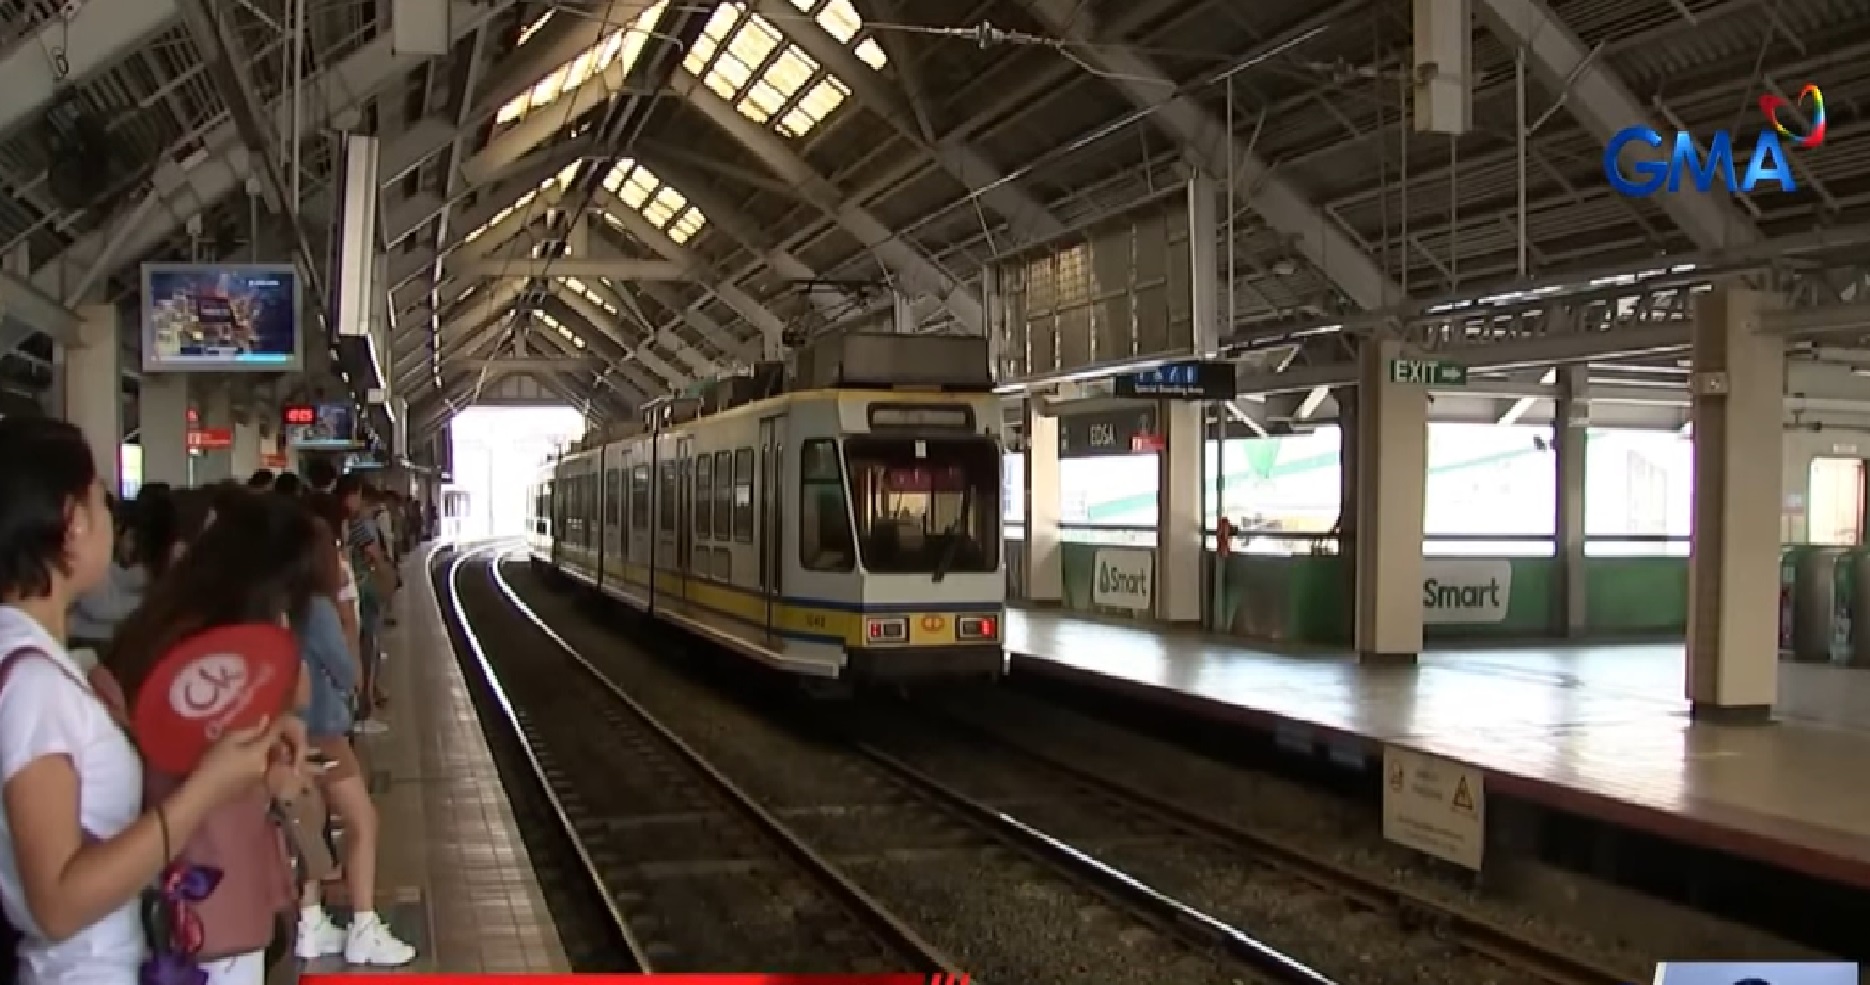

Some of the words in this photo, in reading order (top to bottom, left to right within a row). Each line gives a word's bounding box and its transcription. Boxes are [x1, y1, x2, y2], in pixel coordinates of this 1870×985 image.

[1396, 360, 1438, 384] EXIT
[1089, 423, 1117, 446] EDSA
[1110, 566, 1147, 597] Smart
[1422, 577, 1500, 609] Smart
